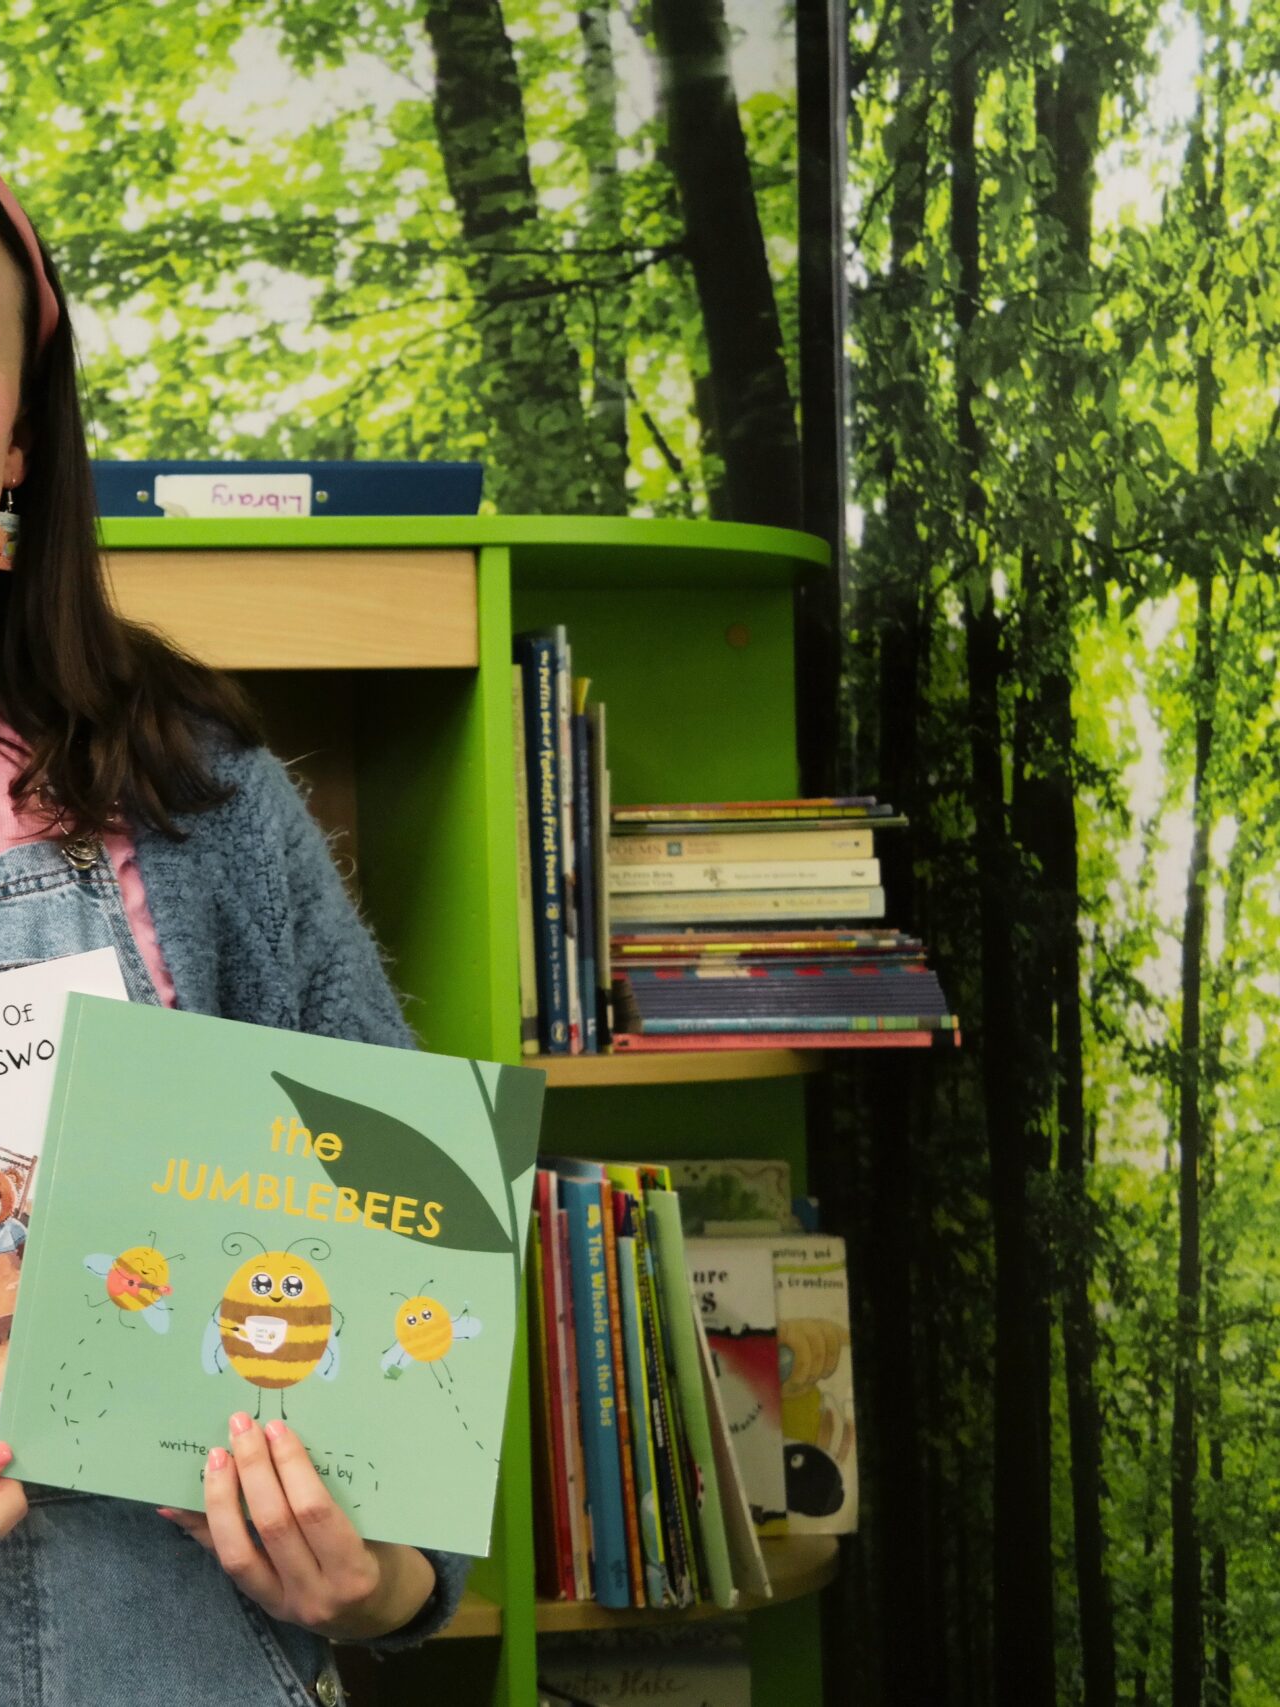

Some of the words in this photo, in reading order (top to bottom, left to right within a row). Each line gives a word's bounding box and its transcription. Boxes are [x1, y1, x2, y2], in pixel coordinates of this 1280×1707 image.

[211, 483, 302, 514] Library
[538, 667, 551, 710] Puffin
[539, 750, 556, 814] Fantastic
[542, 816, 557, 852] First
[545, 854, 557, 894] Poems
[2, 1003, 35, 1027] Of
[269, 1115, 344, 1162] the
[151, 1157, 444, 1239] JUMBLEBEES
[588, 1233, 602, 1267] The
[692, 1270, 729, 1285] ure
[591, 1272, 609, 1334] Wheels
[595, 1338, 606, 1359] on
[597, 1363, 612, 1392] the
[600, 1396, 613, 1427] Bus
[159, 1439, 211, 1456] writte
[337, 1464, 353, 1484] by
